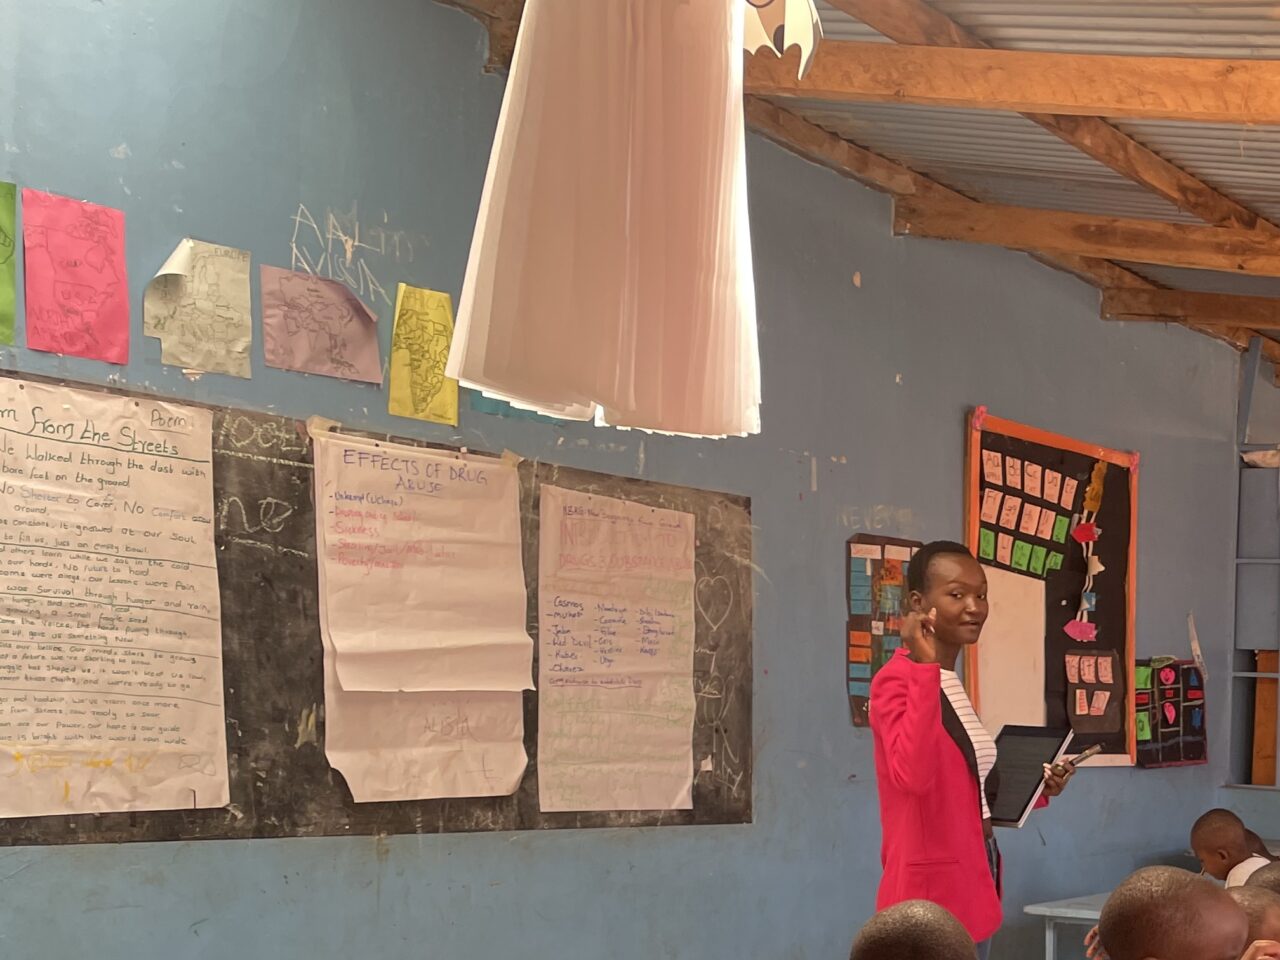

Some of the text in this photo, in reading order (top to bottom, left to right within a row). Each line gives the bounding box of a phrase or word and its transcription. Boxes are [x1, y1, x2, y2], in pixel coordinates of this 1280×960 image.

[151, 408, 187, 428] Poem
[80, 418, 111, 444] the
[117, 426, 179, 456] Streets
[80, 450, 123, 475] through
[127, 458, 144, 470] the
[343, 448, 489, 485] EFFECTS OF DRUG
[75, 471, 94, 484] the
[97, 474, 131, 491] ground
[394, 475, 443, 494] ABUSE
[123, 500, 145, 515] No
[121, 526, 136, 537] at
[143, 530, 162, 538] our
